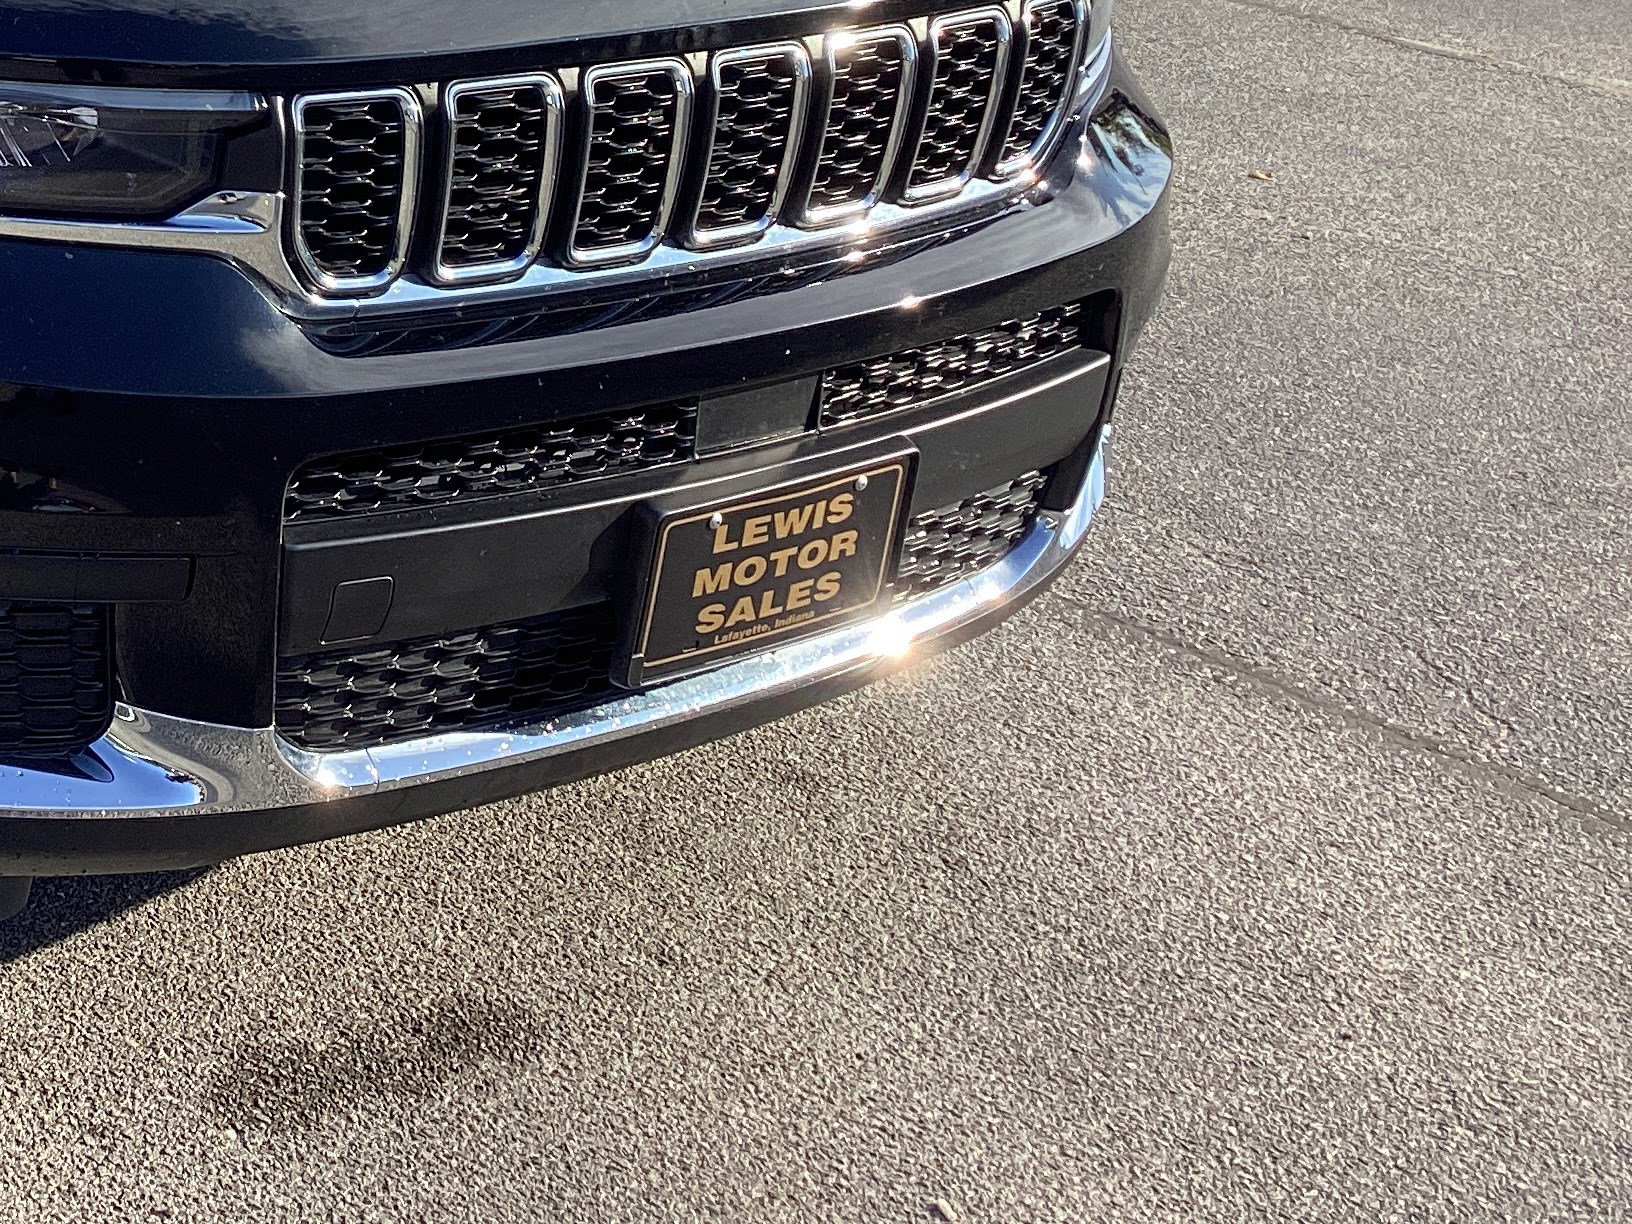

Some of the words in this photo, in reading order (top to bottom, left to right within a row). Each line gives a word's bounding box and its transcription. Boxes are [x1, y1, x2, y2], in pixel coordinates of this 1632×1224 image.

[712, 492, 855, 555] LEWIS
[691, 529, 859, 598] MOTOR
[695, 571, 842, 634] SALES
[774, 610, 815, 628] Indiana
